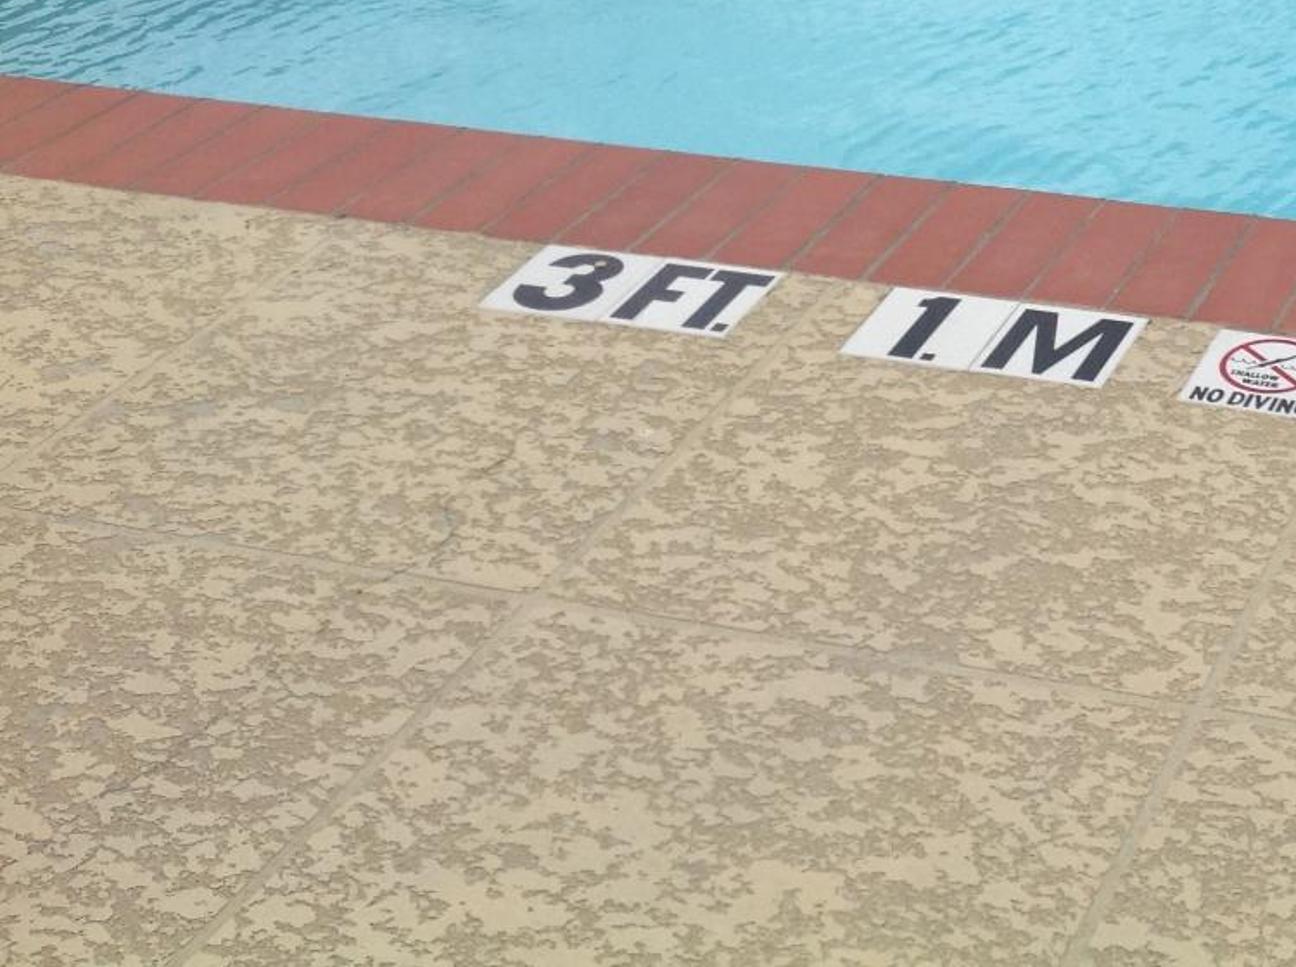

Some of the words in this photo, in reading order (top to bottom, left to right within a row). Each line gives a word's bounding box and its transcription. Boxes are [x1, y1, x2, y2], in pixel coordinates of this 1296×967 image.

[512, 253, 624, 312] 3
[980, 308, 1135, 383] M
[1231, 369, 1280, 381] SHALLOW
[1241, 377, 1280, 389] WATER
[1189, 385, 1225, 403] NO
